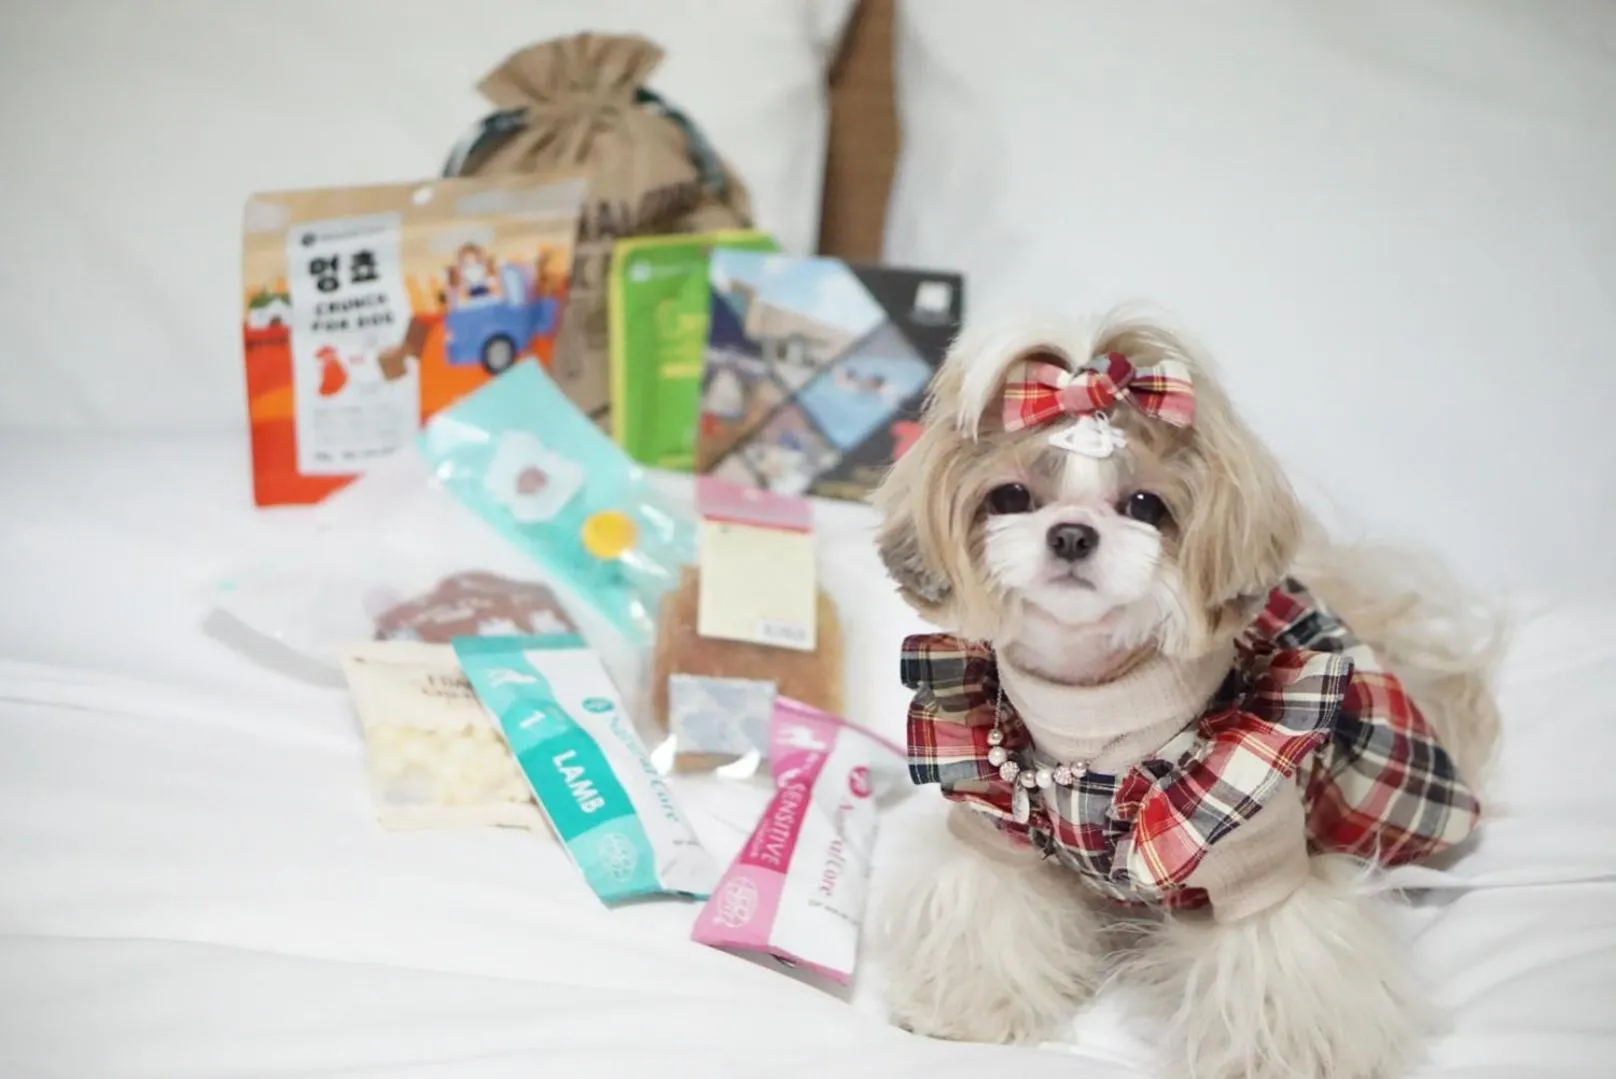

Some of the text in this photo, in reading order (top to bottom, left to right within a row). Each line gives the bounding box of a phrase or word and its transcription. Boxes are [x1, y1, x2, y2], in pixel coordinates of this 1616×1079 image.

[311, 312, 394, 333] FOR DOG
[552, 749, 606, 814] LAMB
[761, 781, 807, 867] SENSITIVE
